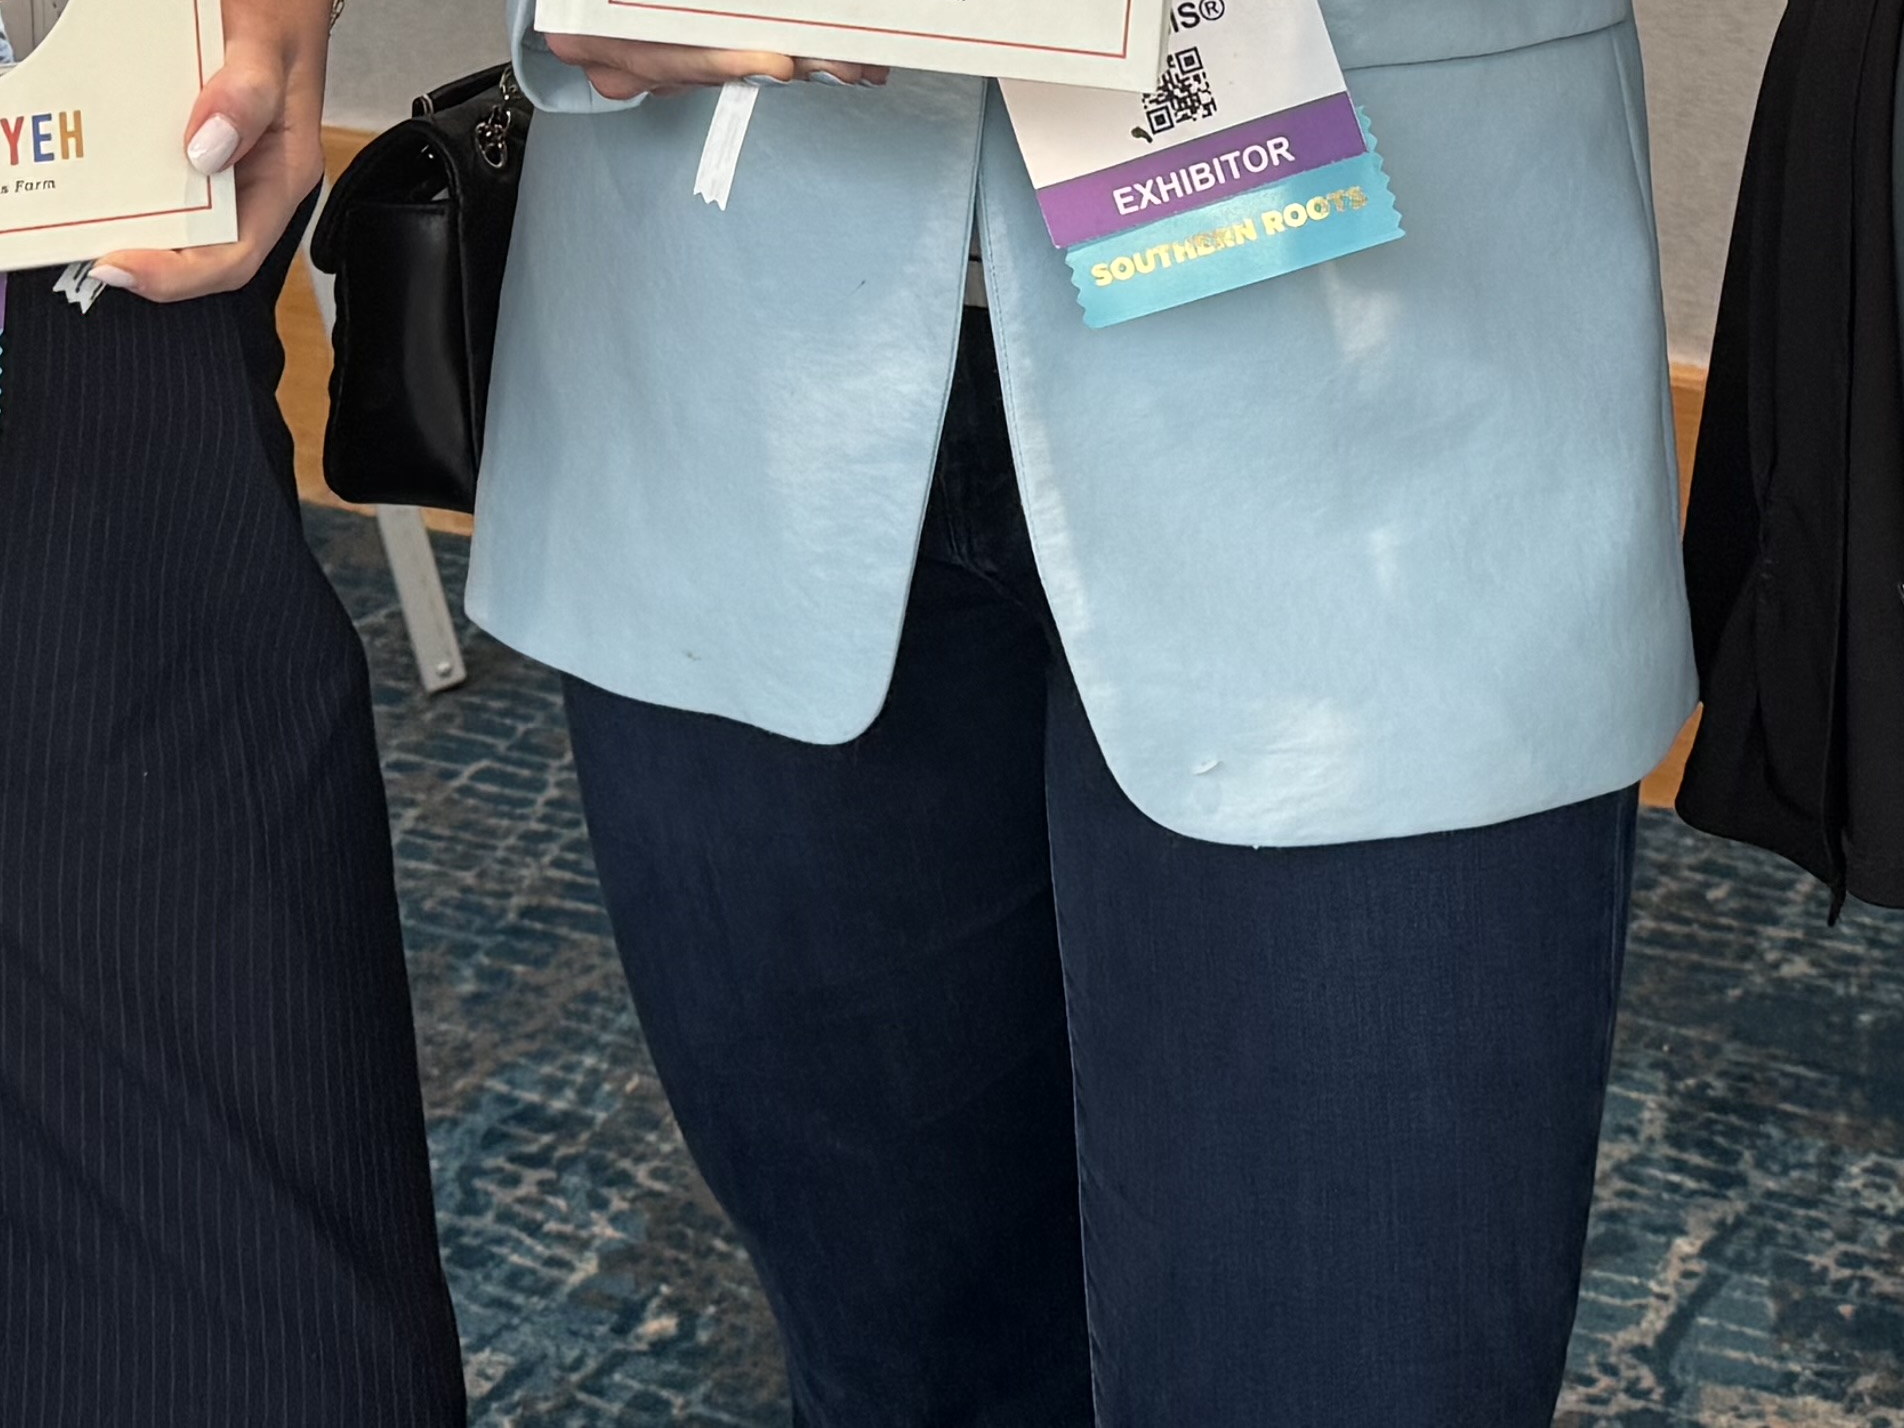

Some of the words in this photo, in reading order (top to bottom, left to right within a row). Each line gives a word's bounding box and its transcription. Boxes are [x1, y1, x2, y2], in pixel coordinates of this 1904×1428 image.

[0, 109, 85, 166] YEH
[15, 179, 56, 193] Farm
[1112, 135, 1295, 216] EXHIBITOR
[1091, 217, 1258, 289] SOUTHERN
[1261, 185, 1369, 235] ROOTS
